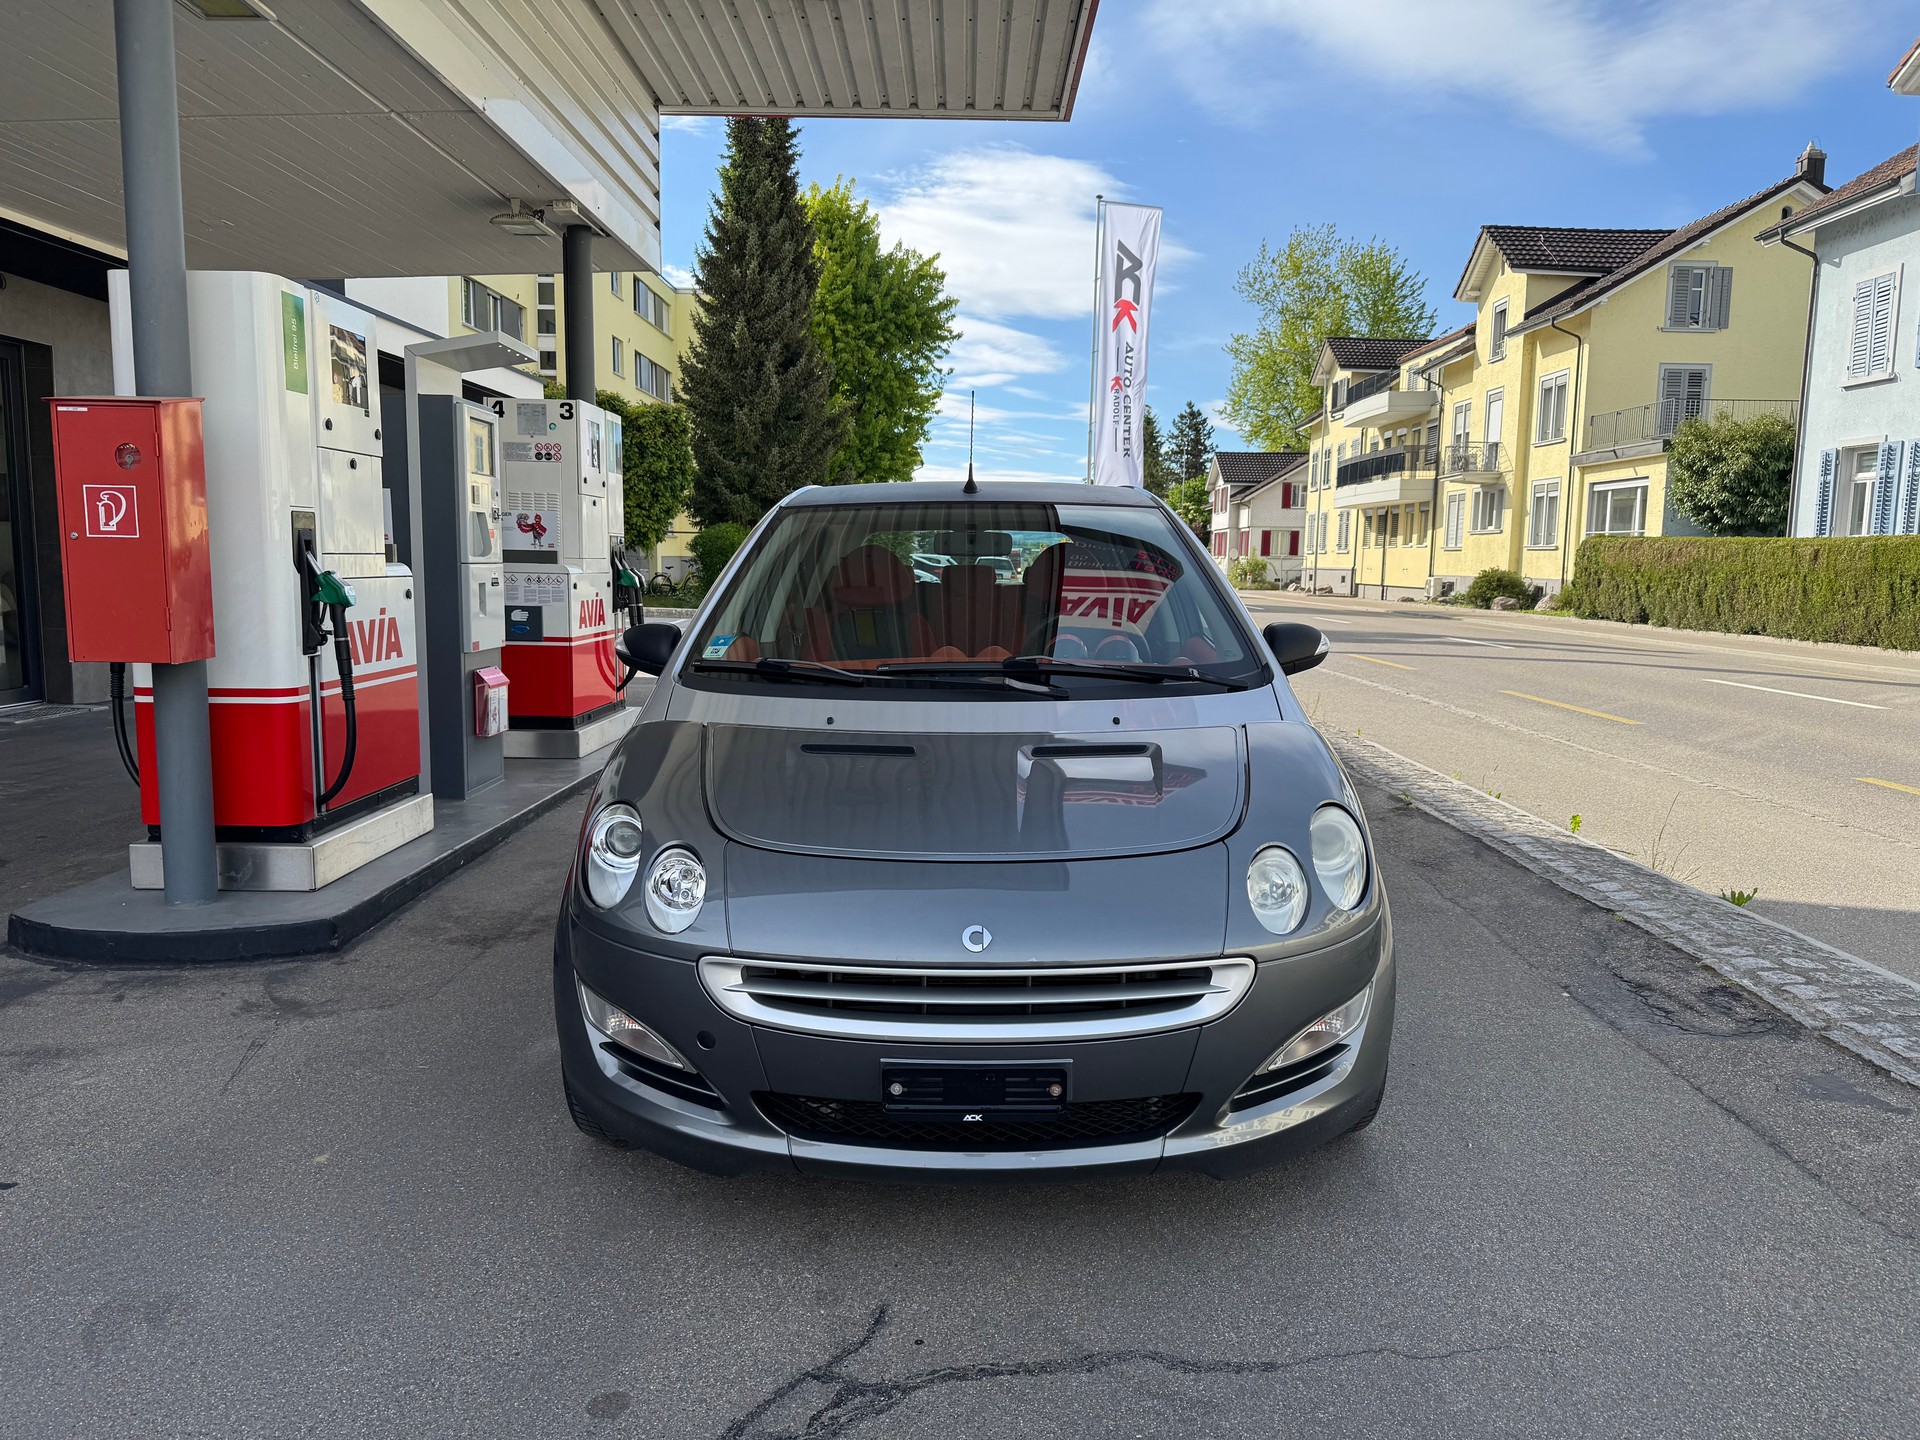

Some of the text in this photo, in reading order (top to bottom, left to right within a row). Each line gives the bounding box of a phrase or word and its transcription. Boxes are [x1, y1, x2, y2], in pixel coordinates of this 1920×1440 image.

[291, 318, 297, 332] 95
[1122, 341, 1134, 458] AUTO CENTER
[491, 400, 505, 418] 4
[559, 402, 574, 420] 3
[579, 591, 606, 629] AVIA
[962, 1114, 983, 1122] ACK
